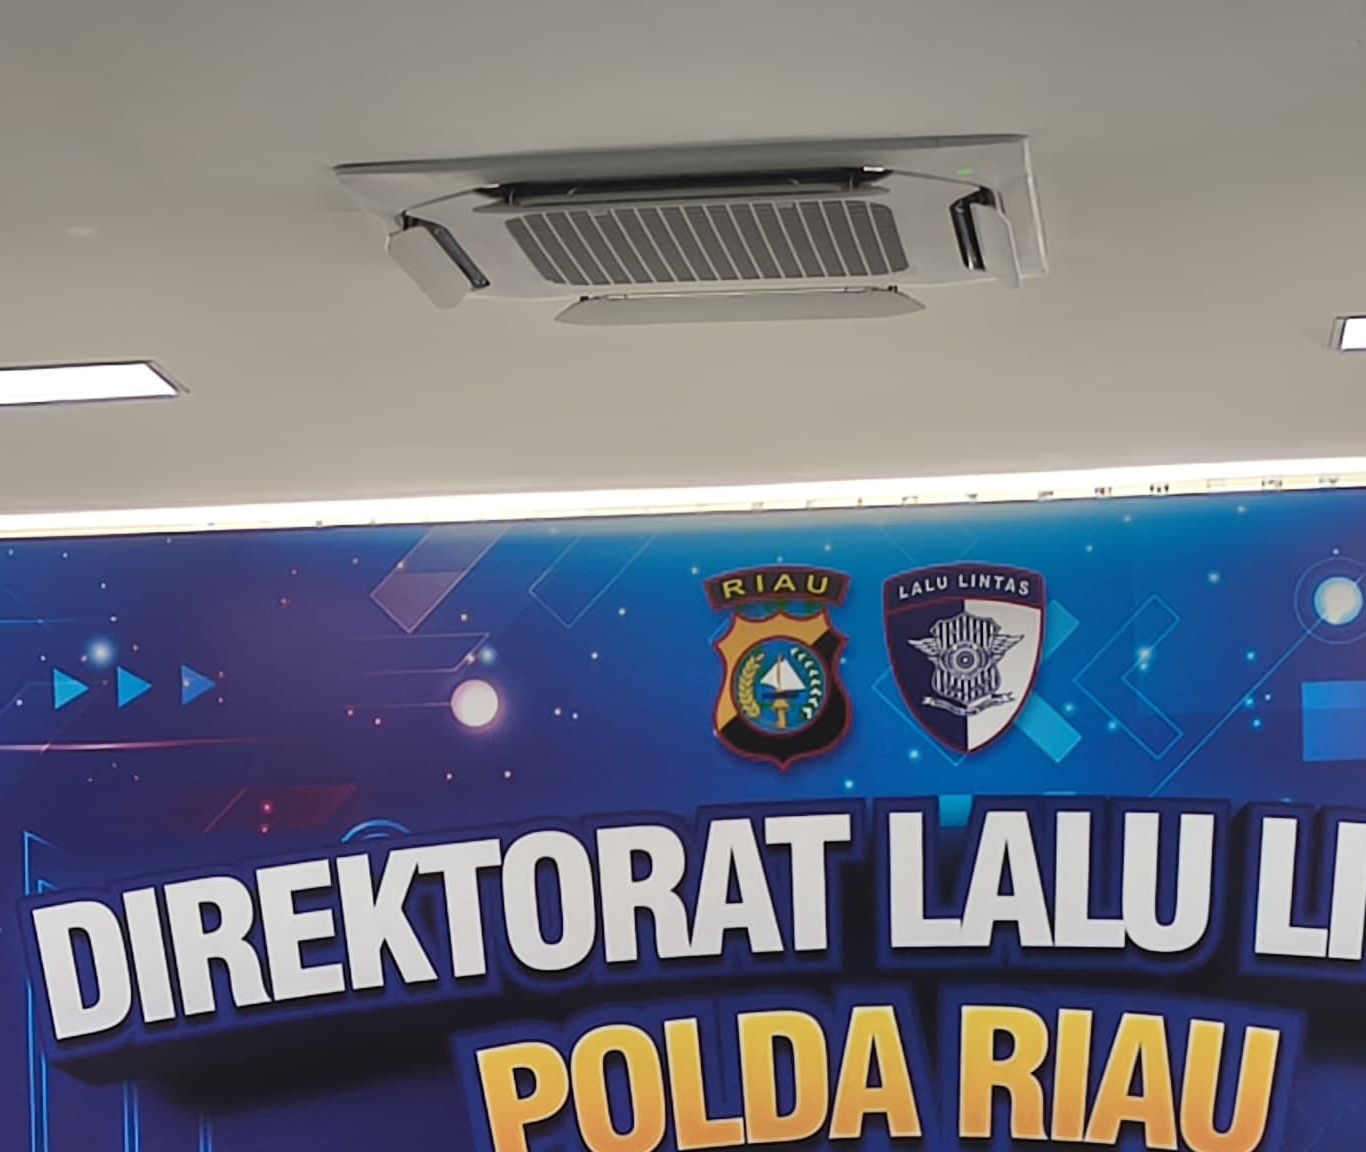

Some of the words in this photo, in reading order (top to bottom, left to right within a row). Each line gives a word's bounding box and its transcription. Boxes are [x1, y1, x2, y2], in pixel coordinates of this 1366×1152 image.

[722, 573, 829, 599] RIAU
[898, 574, 948, 600] LALU
[958, 573, 1031, 597] LINTAS
[32, 813, 851, 1040] DIREKTORAT
[888, 811, 1214, 952] LALU
